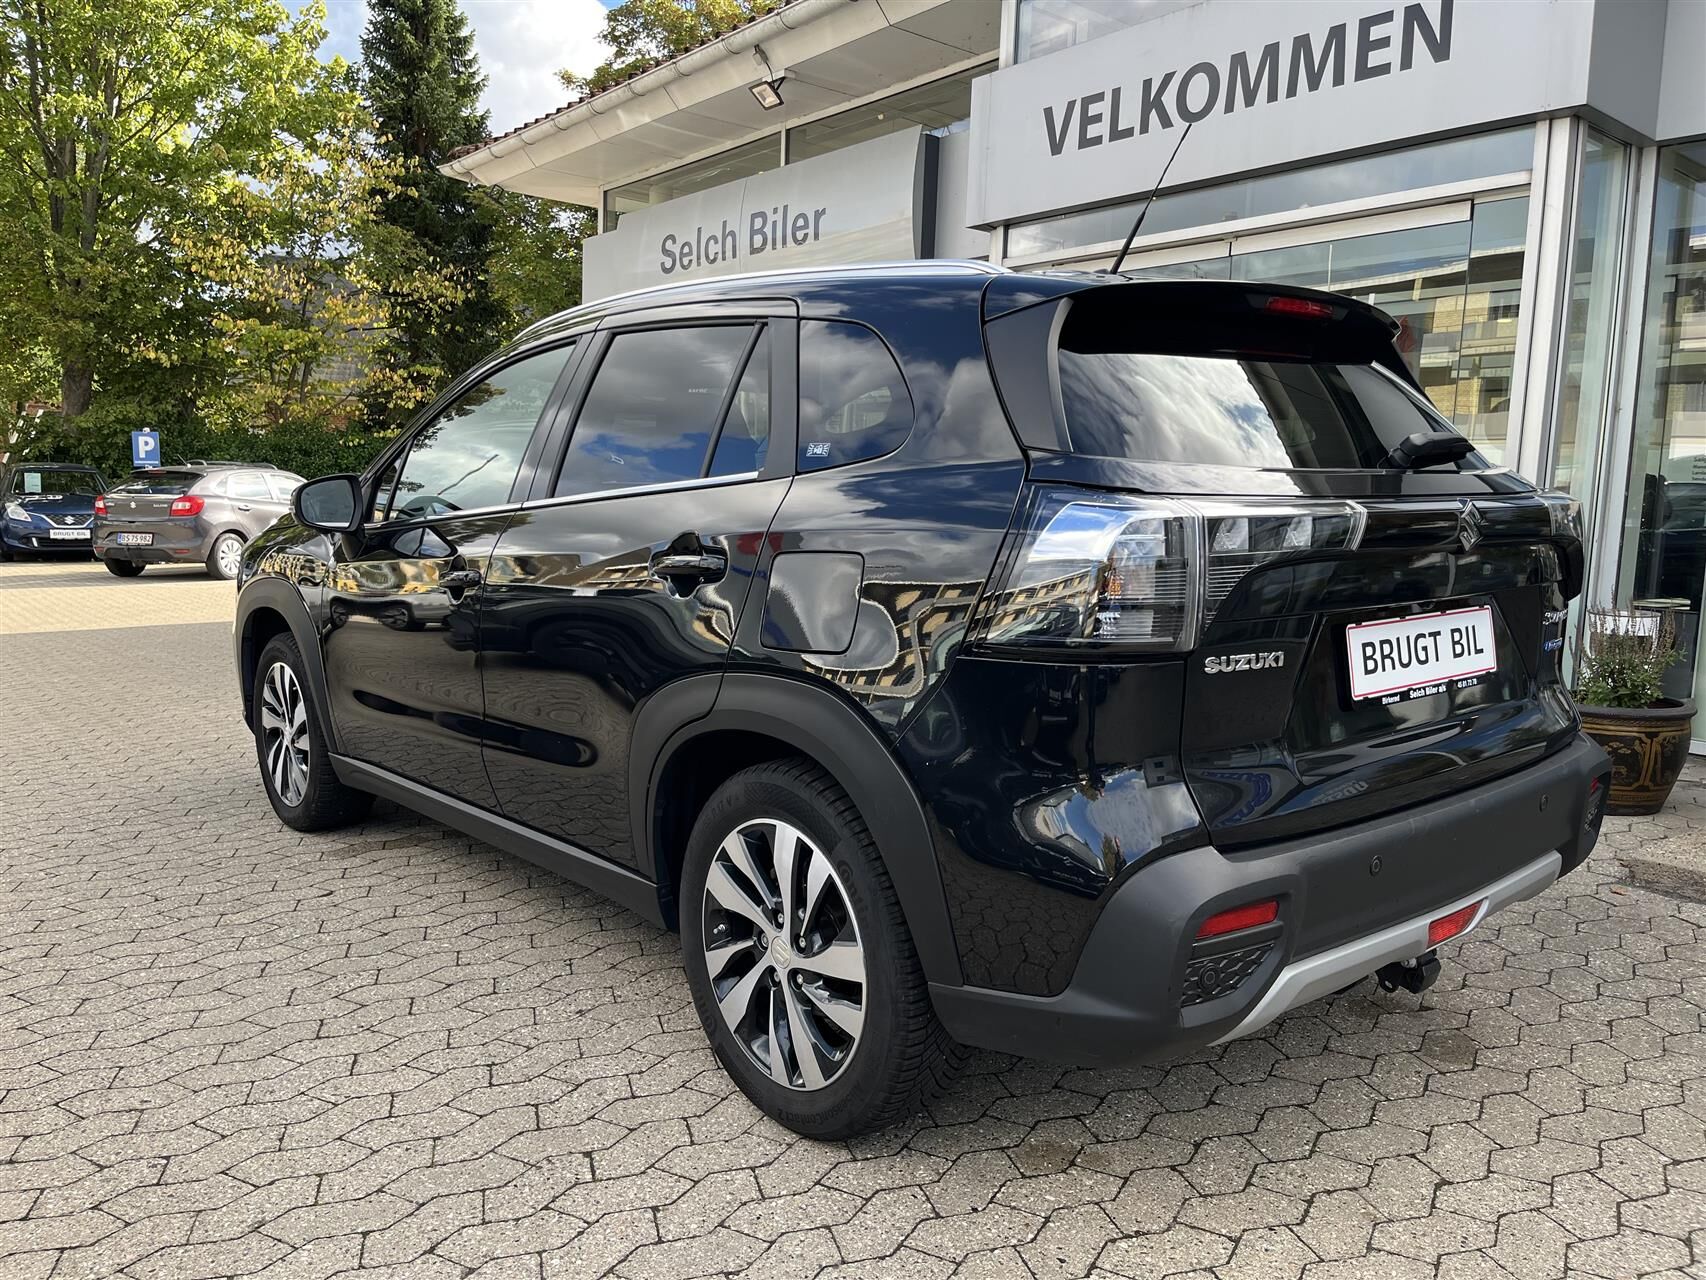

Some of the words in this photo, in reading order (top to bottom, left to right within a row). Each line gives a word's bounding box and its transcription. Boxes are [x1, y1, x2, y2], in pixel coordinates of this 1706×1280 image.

[1042, 0, 1454, 157] VELKOMMEN
[660, 220, 737, 275] Selch
[749, 205, 827, 256] Biler
[138, 436, 155, 458] P
[1204, 651, 1285, 674] SUZUKI
[1361, 630, 1442, 676] BRUGT
[1449, 624, 1484, 659] BIL
[1409, 688, 1425, 699] Selch
[1425, 686, 1438, 695] Biler
